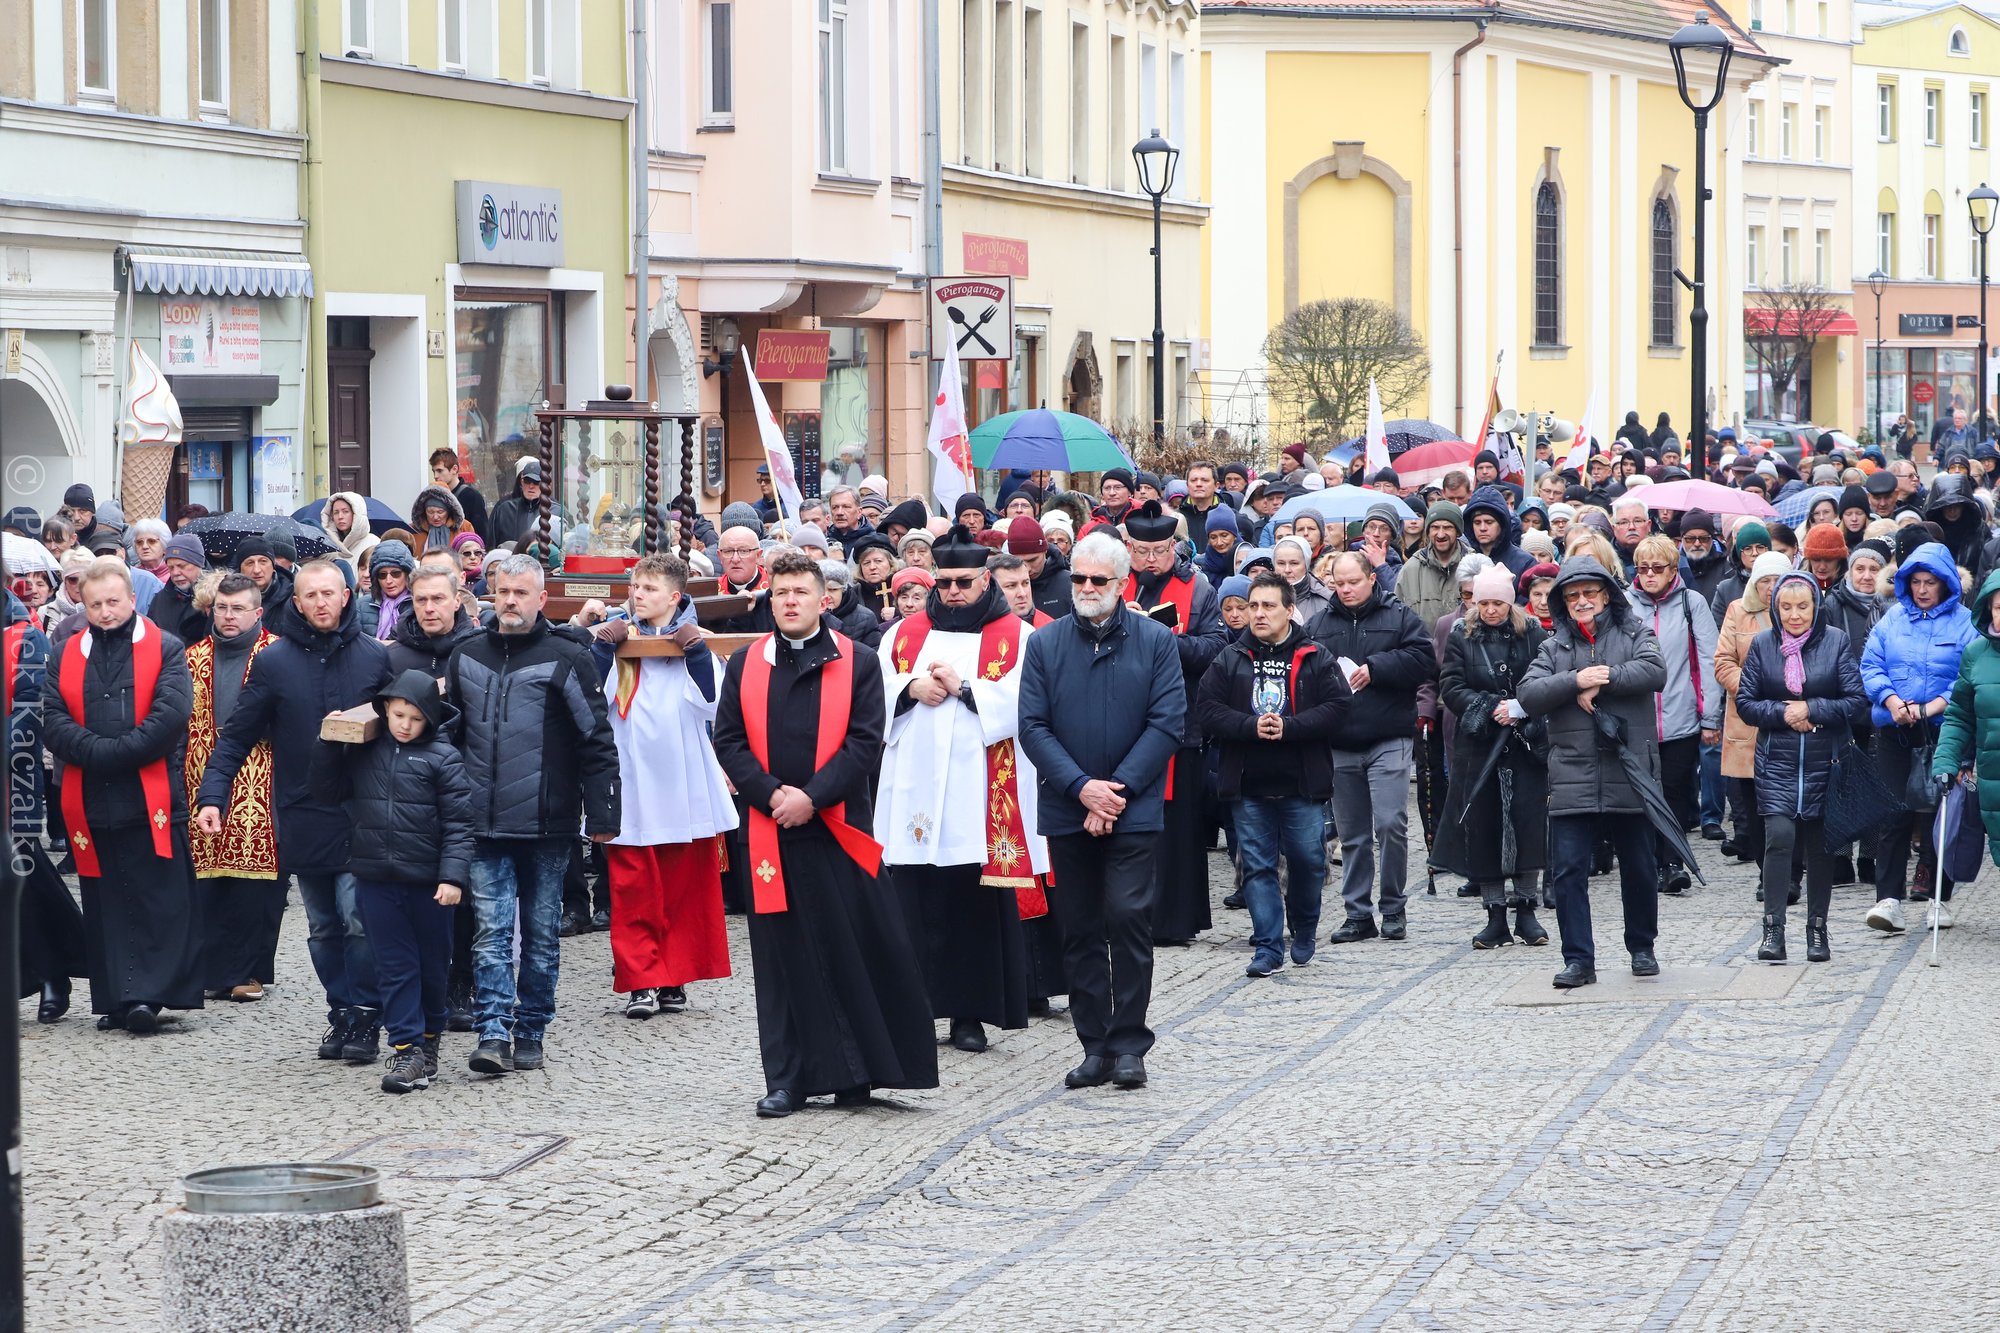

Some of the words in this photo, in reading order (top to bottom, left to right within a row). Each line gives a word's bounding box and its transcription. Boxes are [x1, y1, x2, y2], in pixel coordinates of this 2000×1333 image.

[499, 200, 558, 243] atlantic
[967, 239, 1025, 265] Pierogarnia
[941, 285, 1000, 298] Pierogarnia
[161, 304, 201, 325] LODY
[1909, 316, 1945, 327] OPTYK
[10, 339, 20, 358] 48
[759, 338, 828, 374] Pierogarnia
